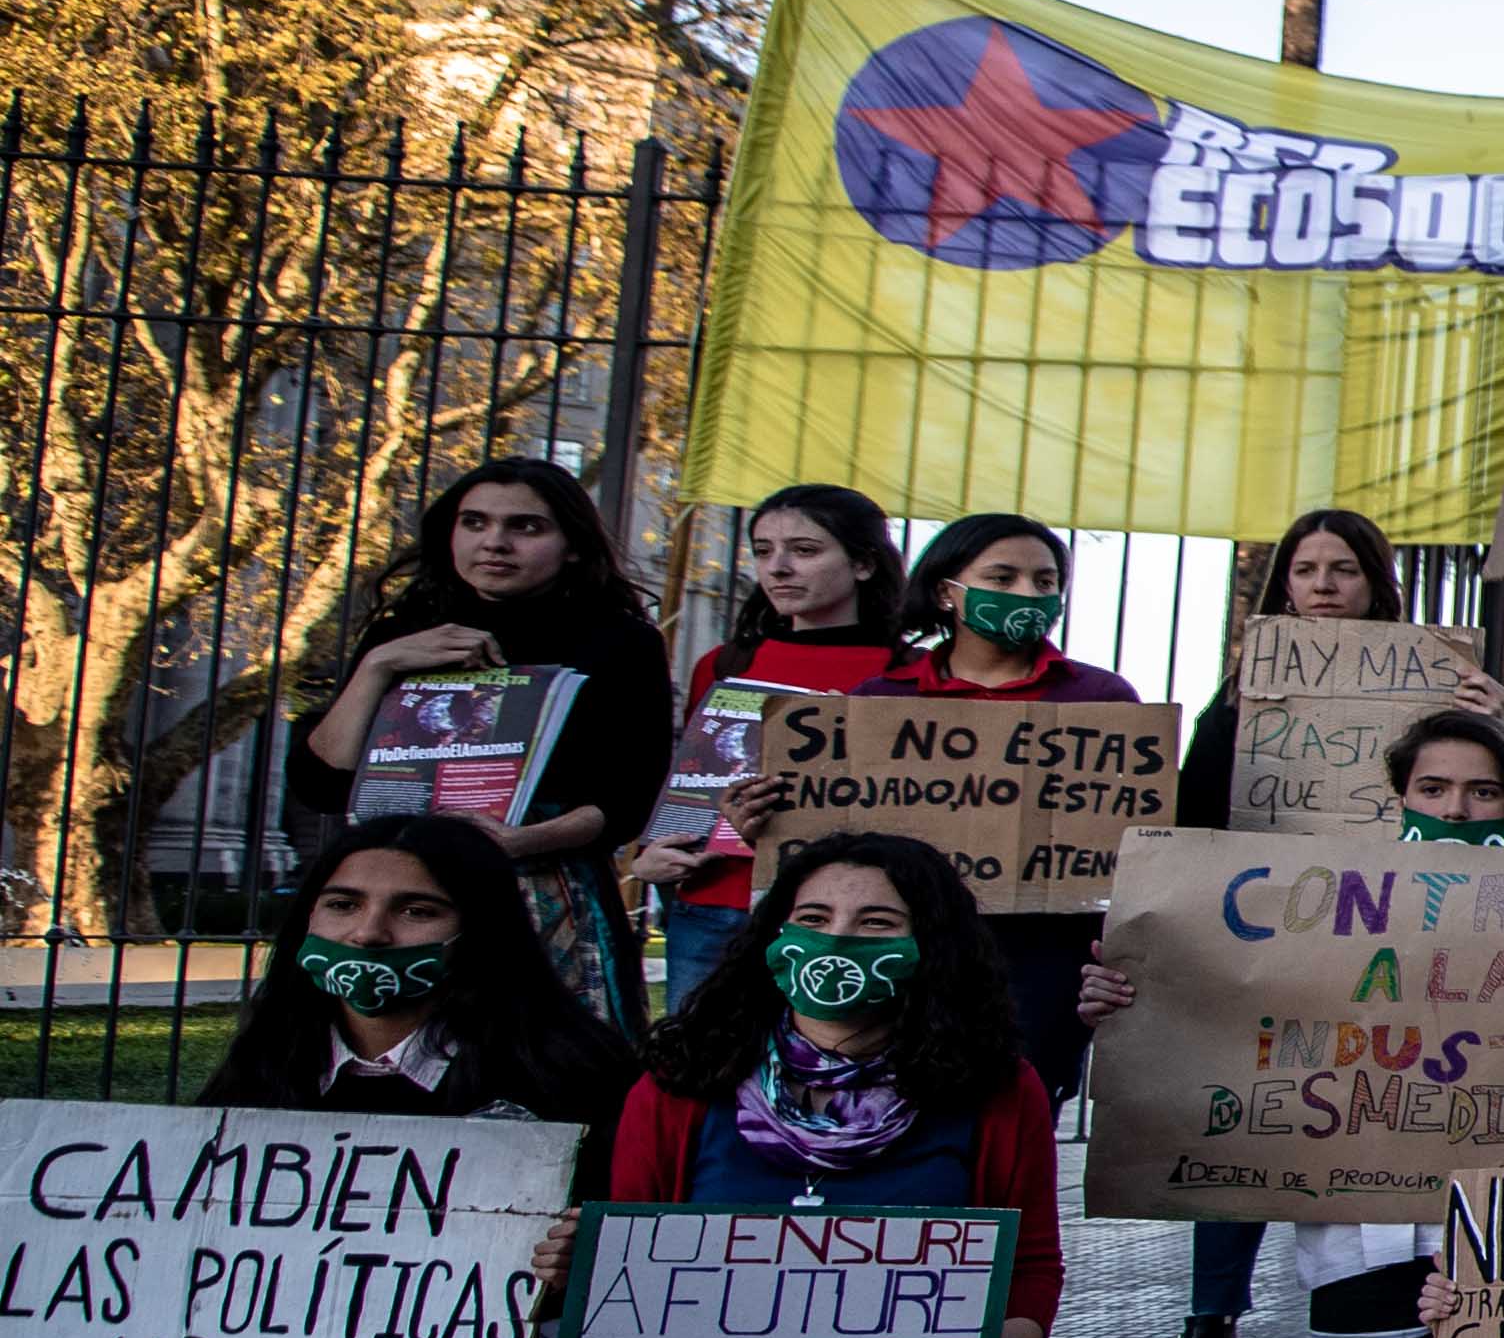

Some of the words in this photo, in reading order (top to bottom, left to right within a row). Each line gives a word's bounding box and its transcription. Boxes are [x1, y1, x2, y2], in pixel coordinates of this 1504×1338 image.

[1248, 622, 1340, 689] HAY
[891, 719, 979, 761] NO
[1005, 722, 1165, 776] ESTAS
[1037, 773, 1163, 819] ESTAS
[600, 1212, 708, 1264] TO
[723, 1213, 1000, 1267] ENSURE
[0, 1238, 141, 1324] LAS
[658, 1268, 994, 1337] FUTURE
